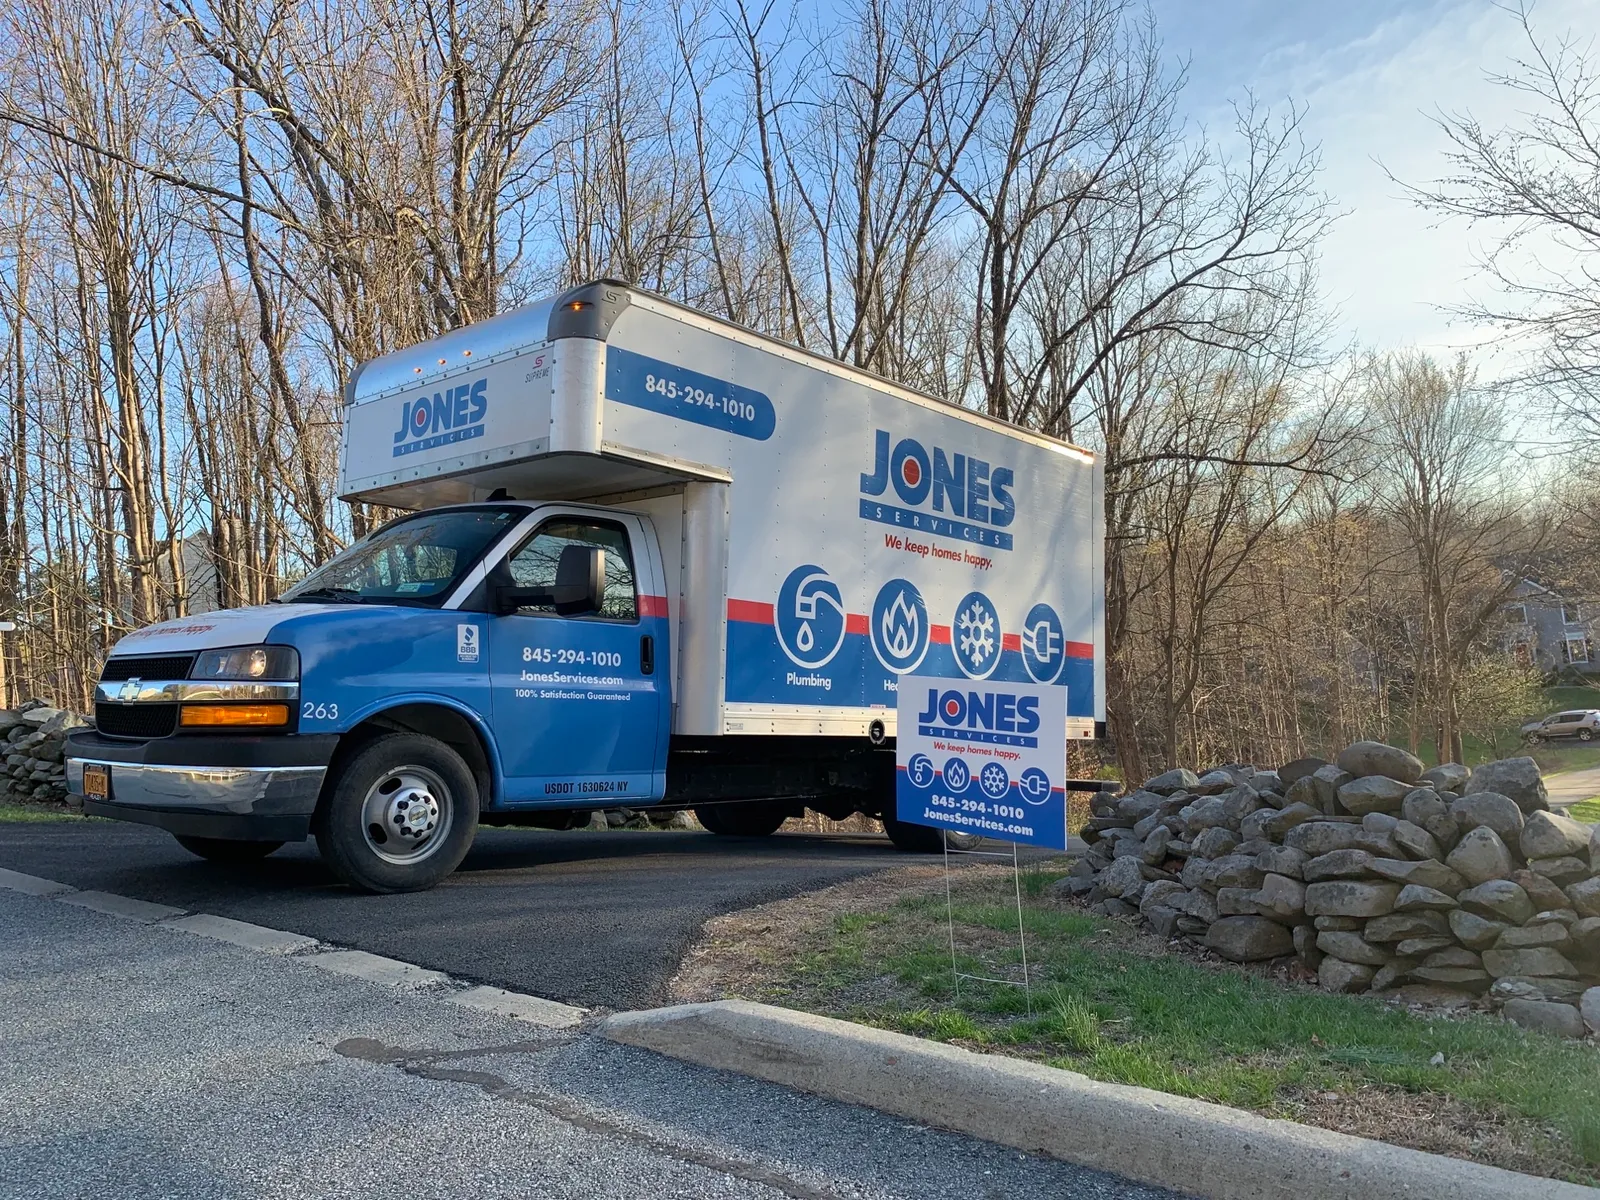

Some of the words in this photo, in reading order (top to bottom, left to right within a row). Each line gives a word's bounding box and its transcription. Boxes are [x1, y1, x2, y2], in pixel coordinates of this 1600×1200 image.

[646, 374, 755, 422] 845-294-1010
[394, 378, 487, 444] JONES
[400, 429, 476, 454] SERVICES
[860, 428, 1016, 528] JONES
[876, 506, 1000, 545] SERVICES
[885, 534, 902, 550] We
[904, 537, 930, 558] keep
[932, 543, 962, 562] homes
[964, 550, 992, 570] happy.
[522, 647, 621, 667] 845-294-1010
[520, 670, 624, 686] JonesServices.com
[786, 672, 832, 690] Plumbing
[515, 688, 538, 698] 100%
[540, 689, 585, 700] Satisfaction
[587, 692, 630, 701] Guaranteed
[302, 702, 338, 720] 263
[918, 688, 1040, 734] JONES
[930, 728, 1025, 745] SERVICES
[934, 741, 946, 750] We
[948, 742, 966, 754] keep
[967, 746, 992, 756] homes
[994, 748, 1021, 760] happy.
[544, 782, 574, 794] USDOT
[577, 782, 614, 793] 1630624
[617, 781, 628, 792] NY
[932, 794, 1024, 820] 845-294-1010
[924, 807, 1034, 836] JonesServices.com
